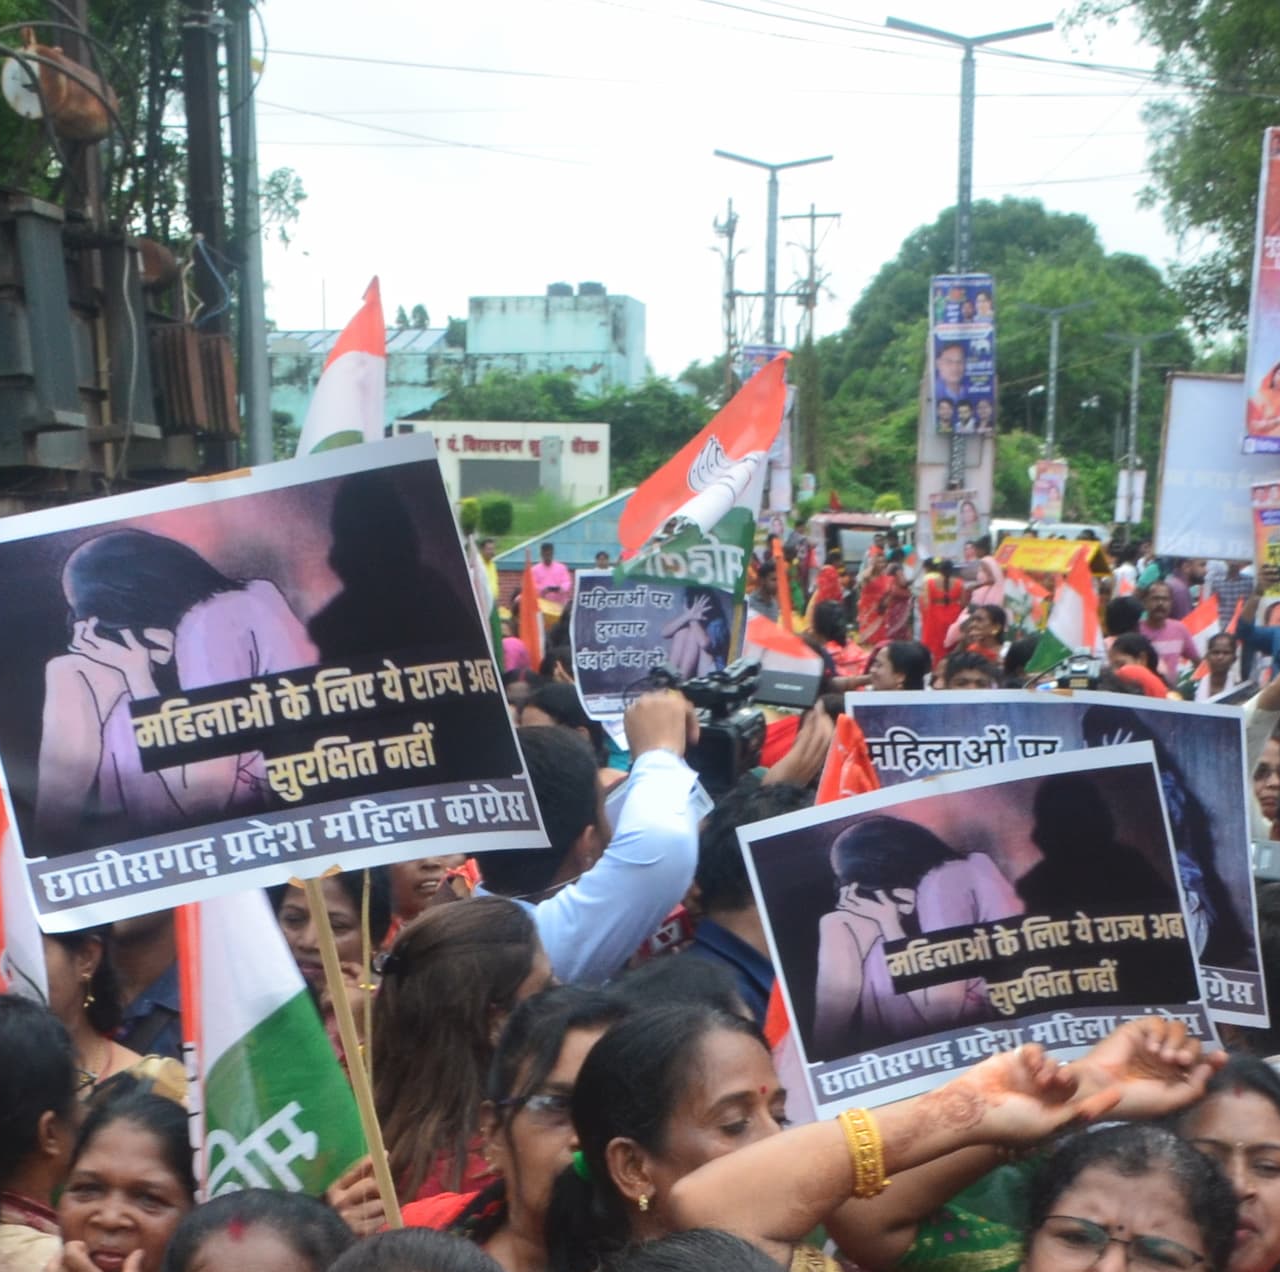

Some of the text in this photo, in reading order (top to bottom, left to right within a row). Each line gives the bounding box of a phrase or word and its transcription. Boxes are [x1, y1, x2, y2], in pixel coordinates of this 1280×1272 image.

[579, 585, 674, 611] महिलाओं पर
[133, 658, 499, 750] महिलाओं के लिए ये राज्य अब
[264, 721, 437, 802] सुरक्षित नहीं
[863, 725, 1061, 777] महिलाओं पर
[40, 783, 531, 904] छत्तीसगढ़ प्रदेश महिला कांग्रेस
[886, 911, 1187, 978] महिलाओं के लिए ये राज्य अब
[985, 958, 1119, 1015] सुरक्षित नहीं
[818, 1037, 955, 1096] छत्तीसगढ़
